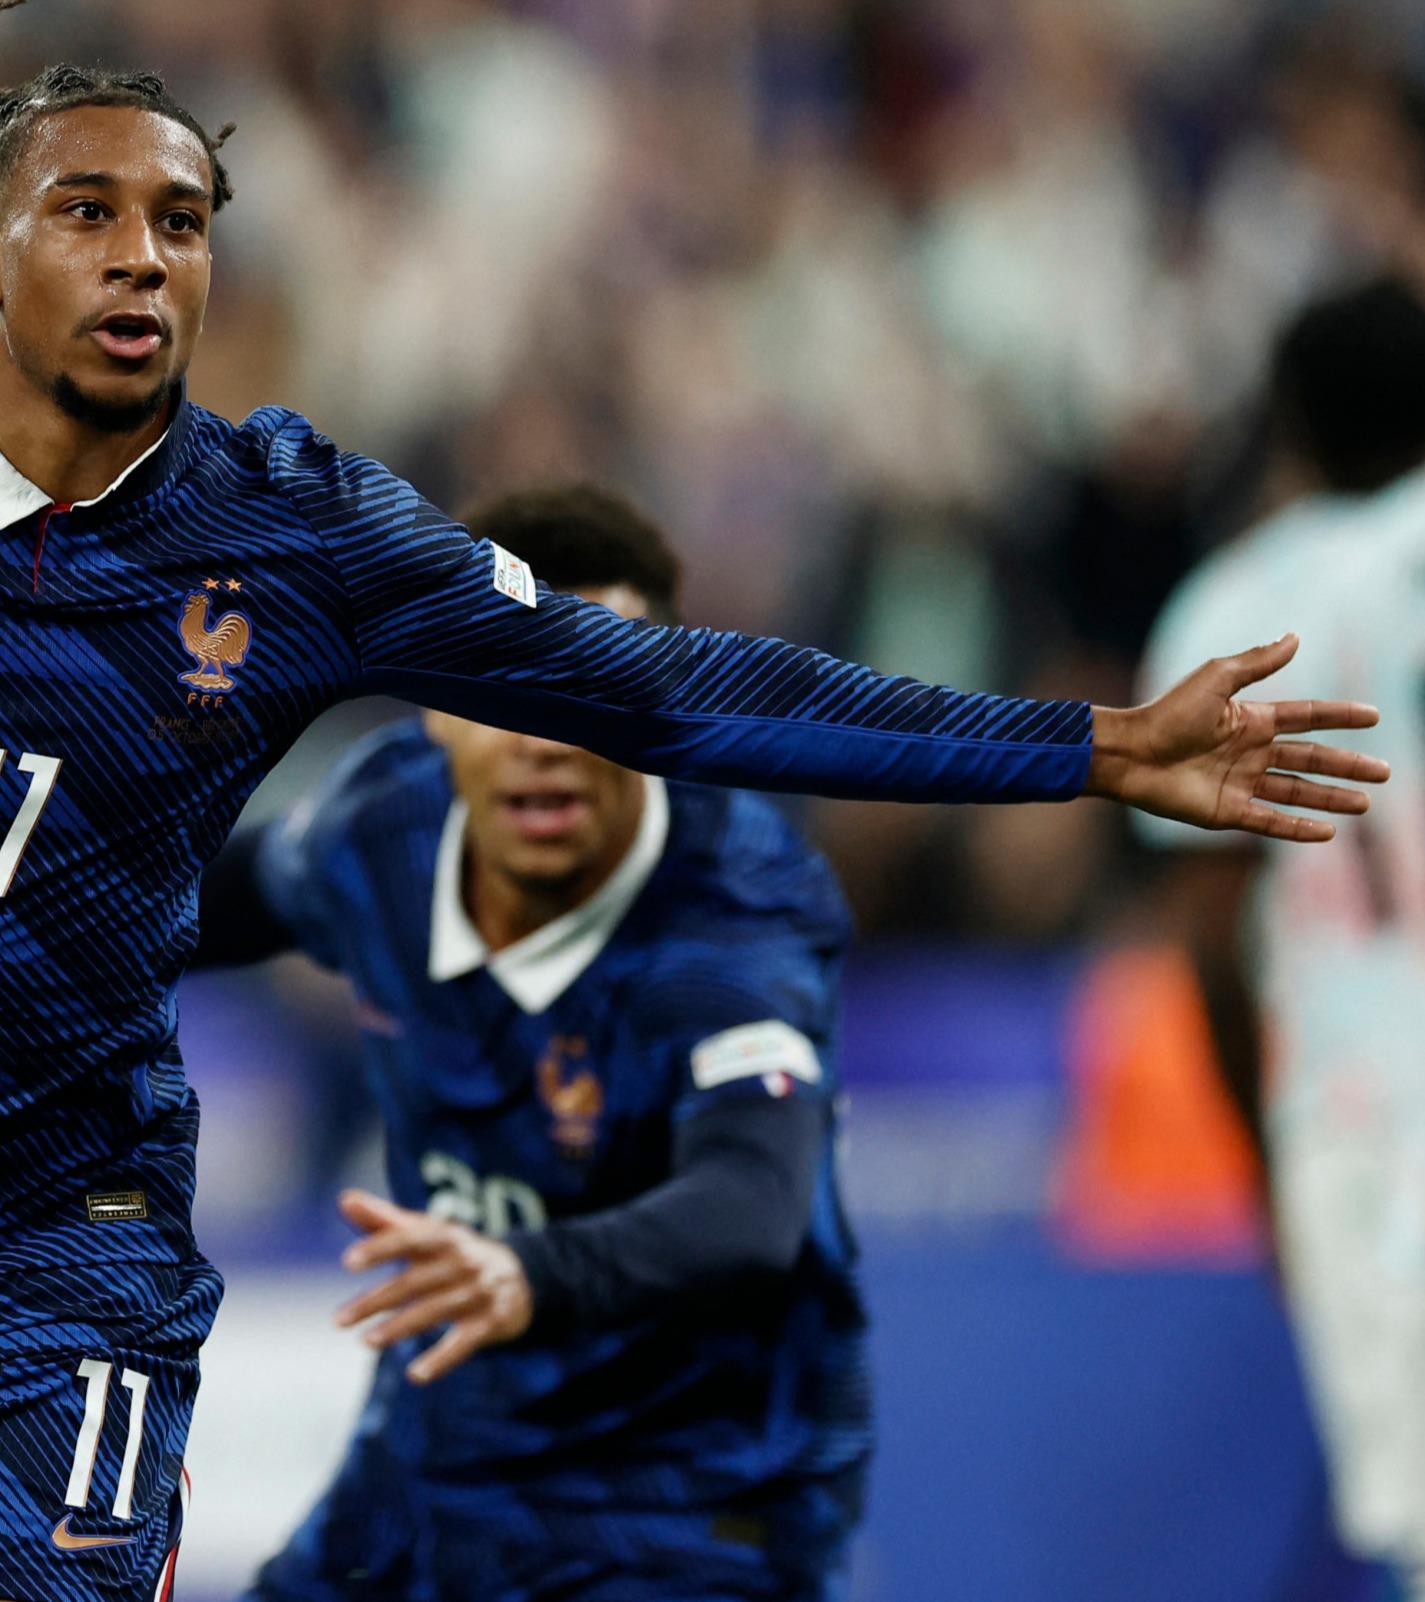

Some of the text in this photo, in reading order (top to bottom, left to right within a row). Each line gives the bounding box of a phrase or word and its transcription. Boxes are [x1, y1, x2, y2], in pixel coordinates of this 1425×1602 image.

[187, 692, 224, 708] FFF
[420, 1151, 546, 1236] 20
[65, 1358, 150, 1519] 11
